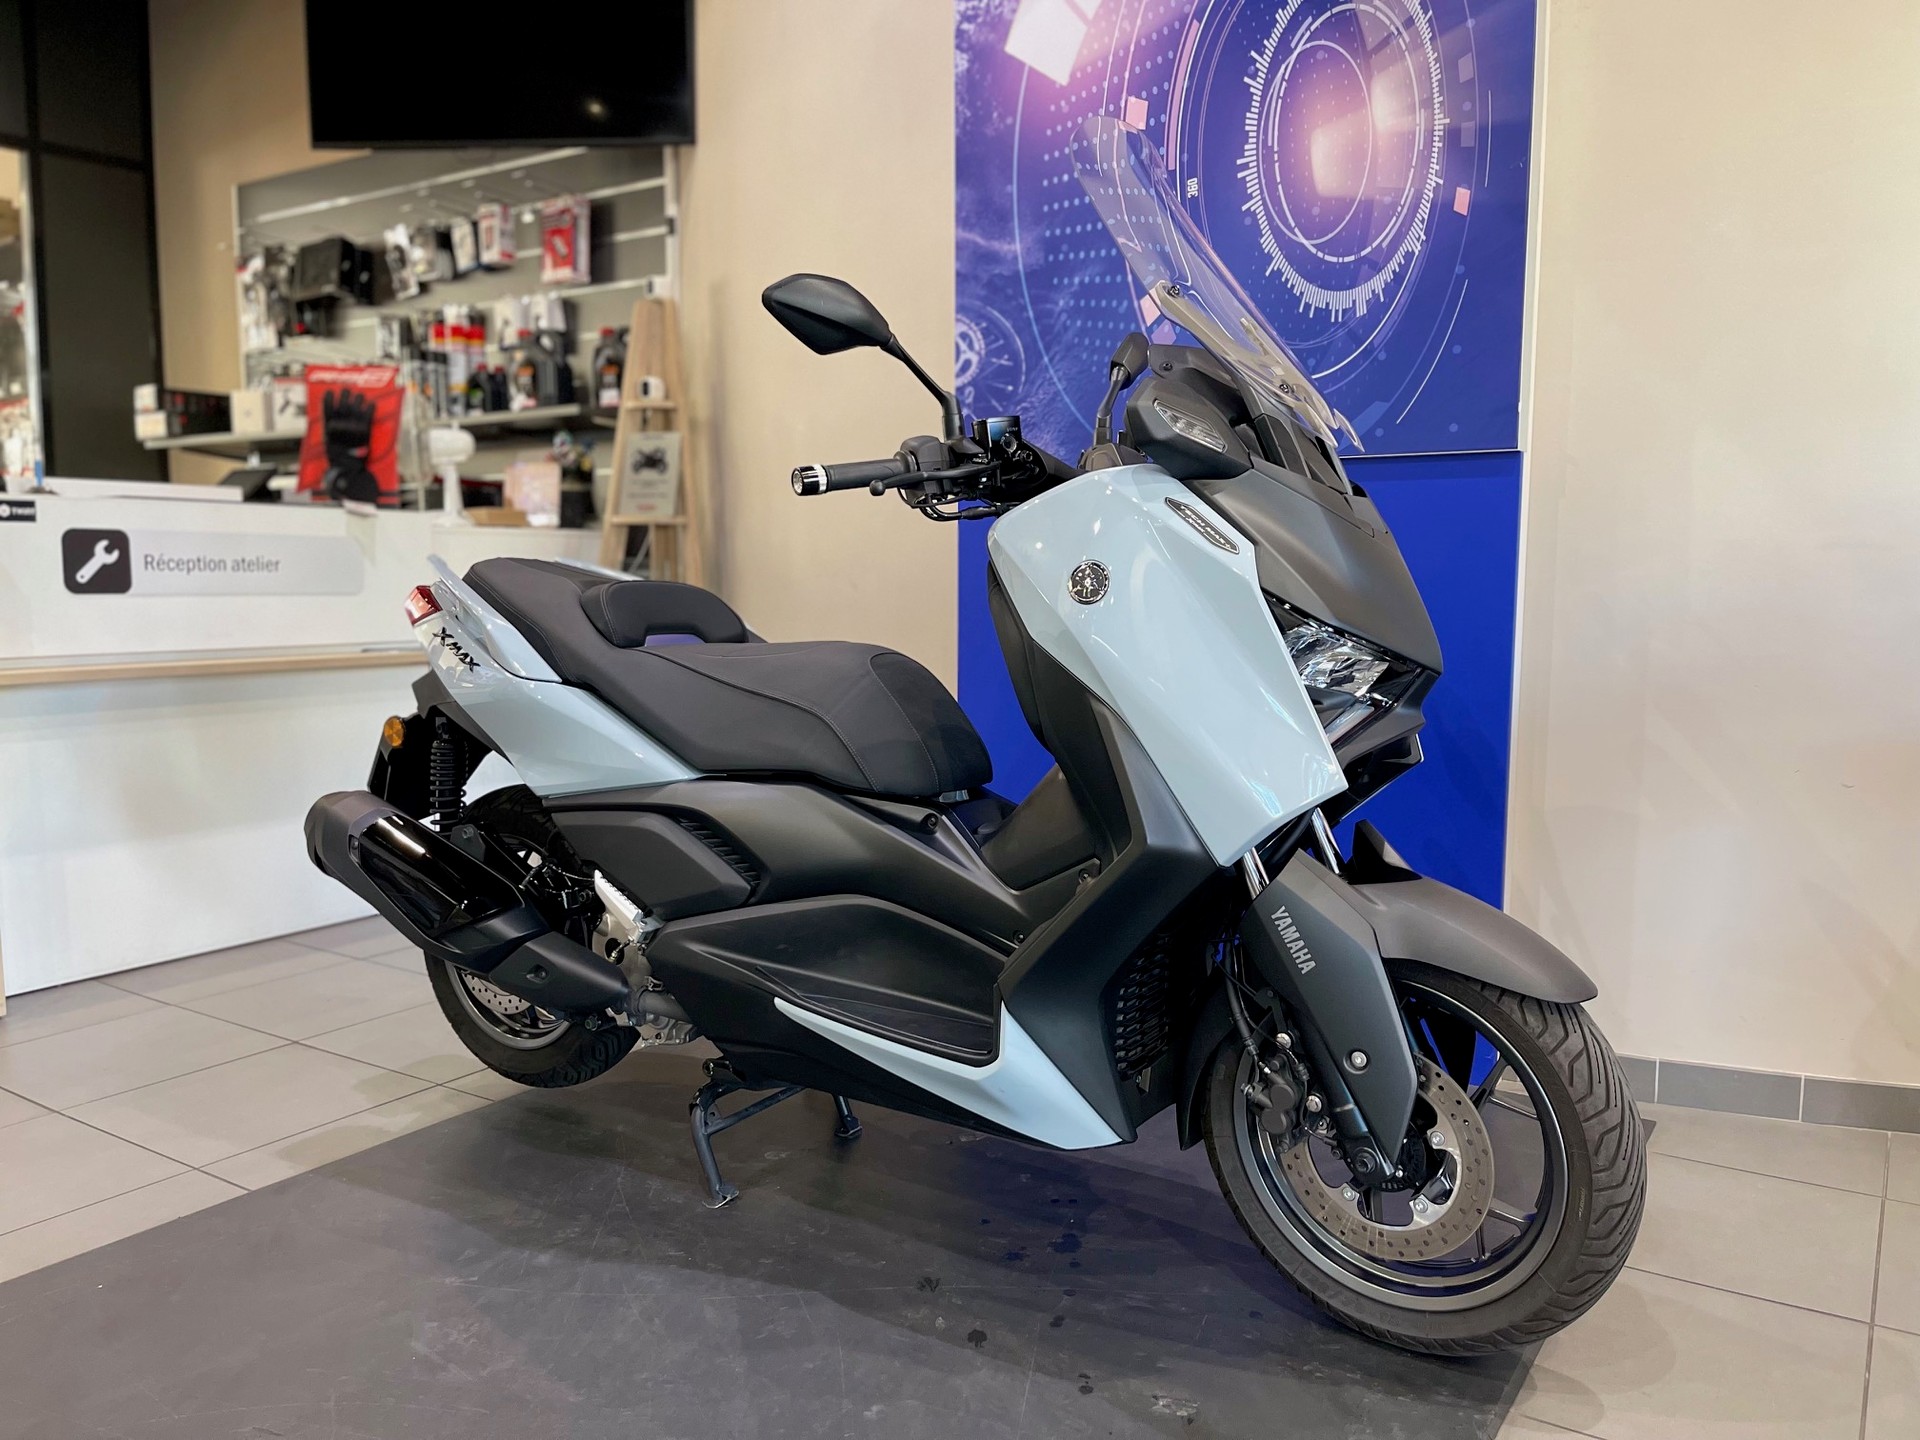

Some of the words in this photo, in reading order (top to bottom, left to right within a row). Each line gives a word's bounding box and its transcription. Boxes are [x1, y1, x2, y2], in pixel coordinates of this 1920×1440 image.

[1187, 177, 1198, 199] 360
[1180, 505, 1206, 527] TECH
[143, 553, 227, 576] Réception
[231, 555, 281, 573] atelier
[432, 626, 481, 674] XMAX
[1271, 905, 1317, 975] YAMAHA
